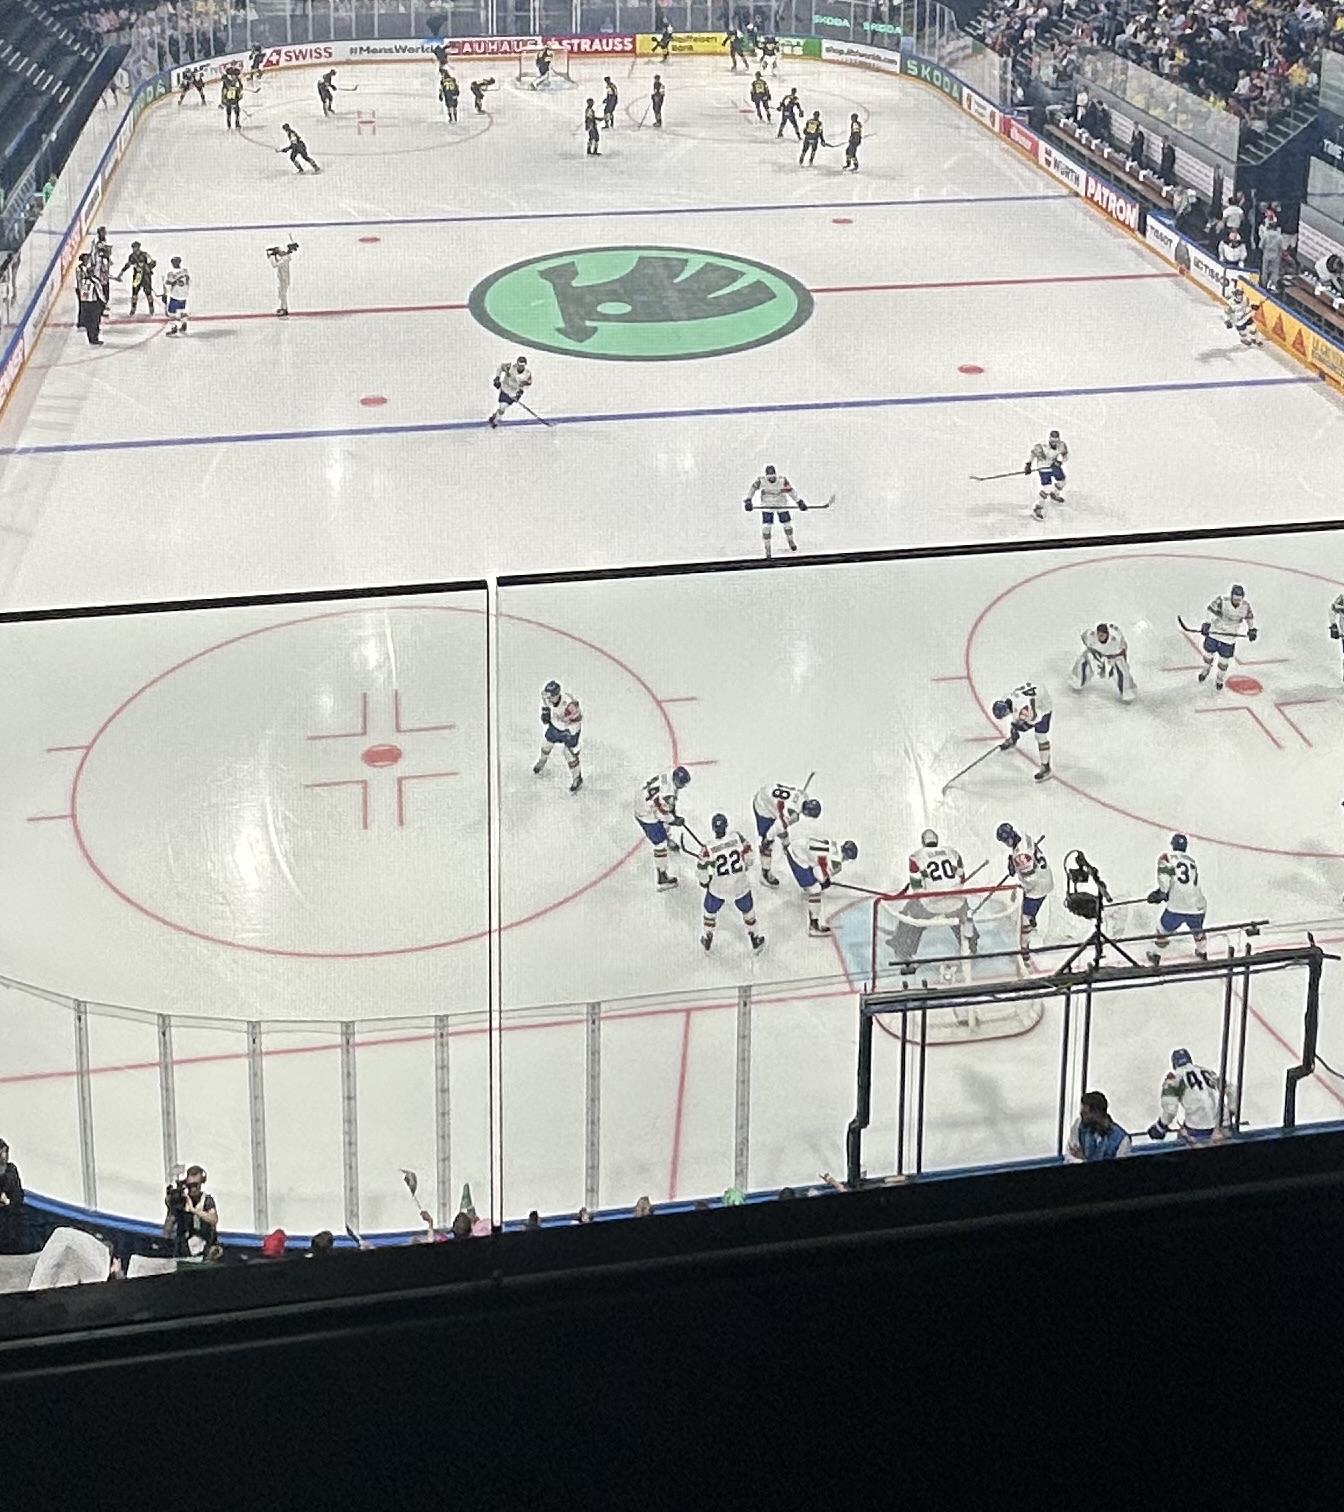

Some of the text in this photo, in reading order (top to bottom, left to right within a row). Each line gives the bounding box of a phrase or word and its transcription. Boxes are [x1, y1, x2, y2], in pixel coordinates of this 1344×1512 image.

[284, 47, 333, 62] SWISS
[562, 38, 633, 53] STRAUSS
[906, 59, 960, 99] SKODA
[716, 849, 744, 877] 22
[926, 858, 957, 882] 20
[1176, 860, 1199, 885] 37
